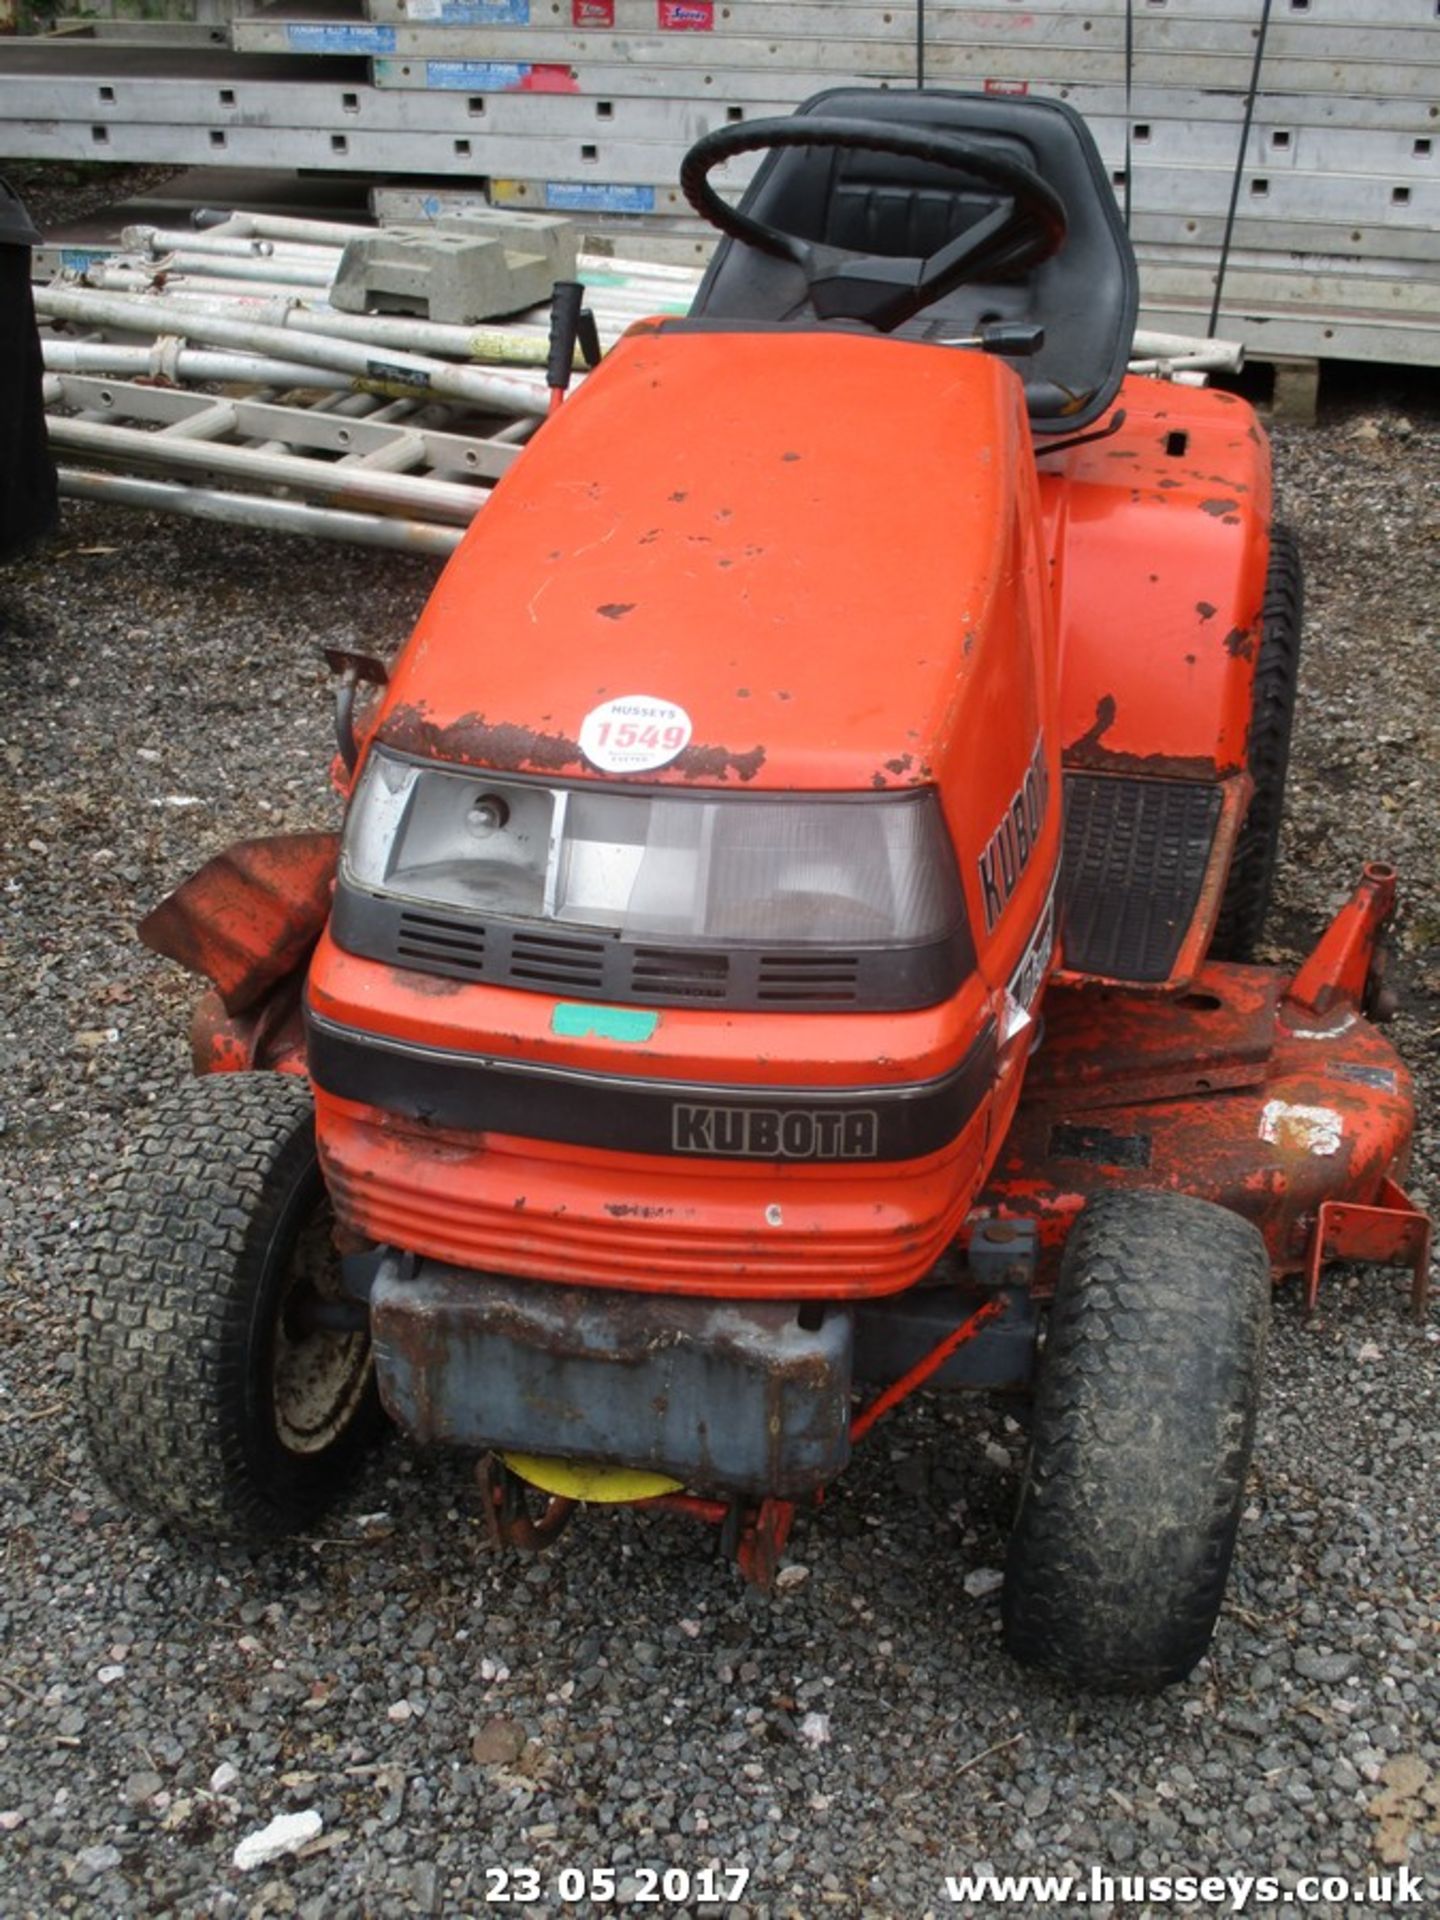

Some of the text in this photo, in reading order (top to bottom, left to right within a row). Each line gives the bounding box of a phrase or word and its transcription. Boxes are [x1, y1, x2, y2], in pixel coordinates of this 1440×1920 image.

[611, 705, 676, 719] HUSSEYS
[597, 722, 685, 750] 1549
[673, 1103, 877, 1157] KUBOTA
